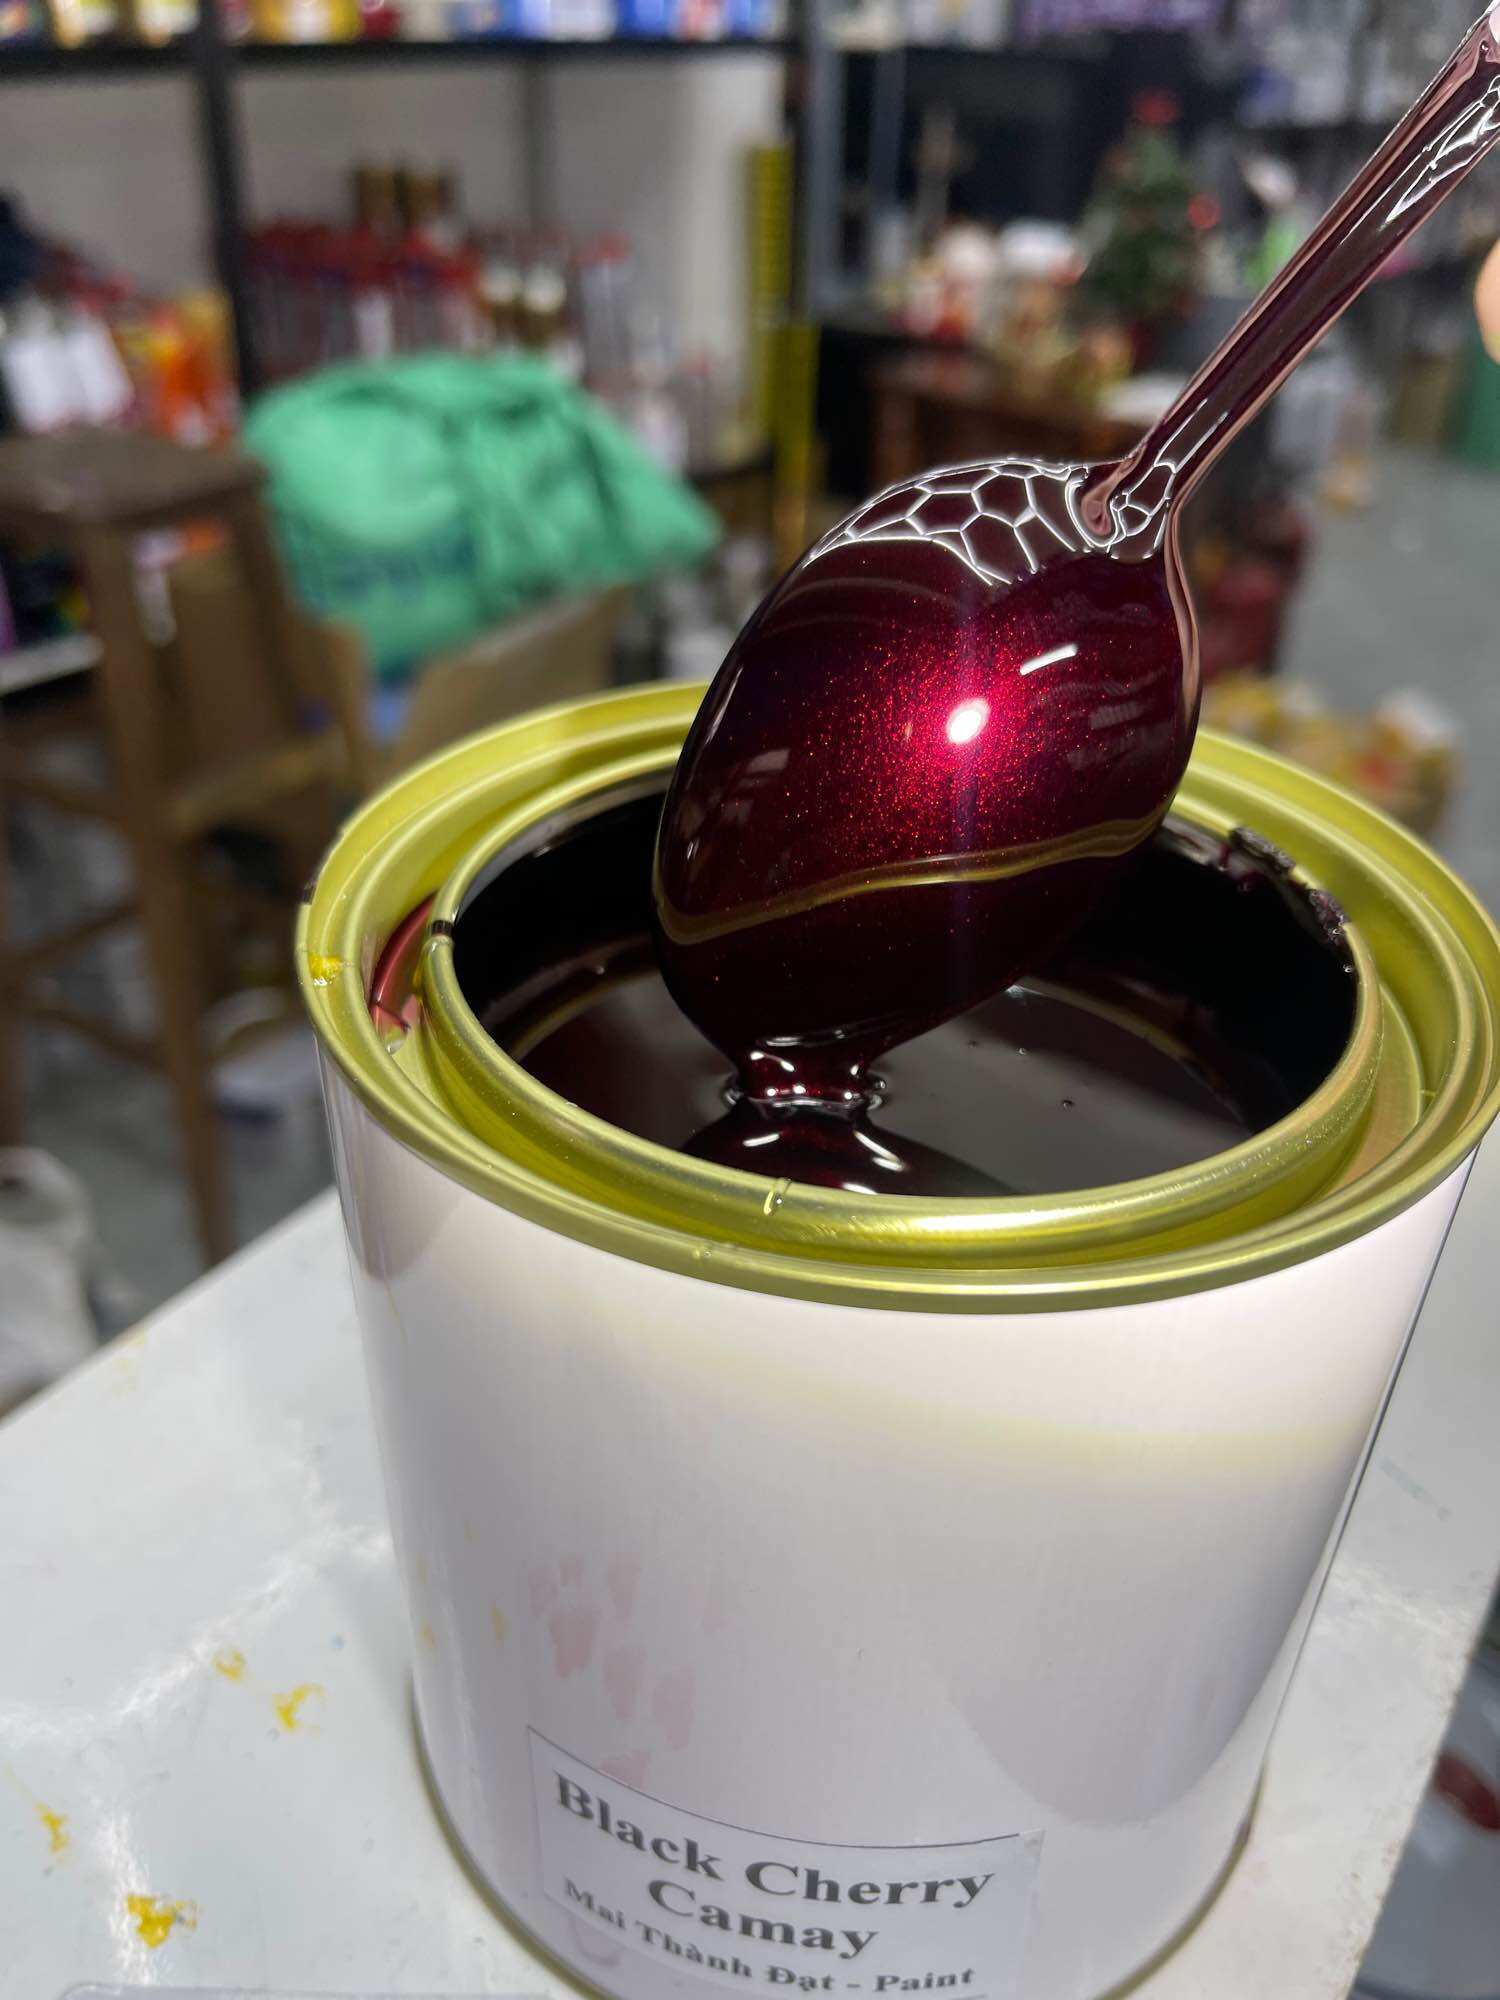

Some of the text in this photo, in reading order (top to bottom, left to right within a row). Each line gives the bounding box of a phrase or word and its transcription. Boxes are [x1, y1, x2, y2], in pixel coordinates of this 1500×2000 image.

[554, 1770, 996, 1909] Black Cherry
[565, 1877, 627, 1930] Mai
[634, 1919, 753, 1979] Thành
[765, 1964, 835, 1994] Đạt
[873, 1967, 976, 1993] Paint
[648, 1878, 879, 1960] Camay
